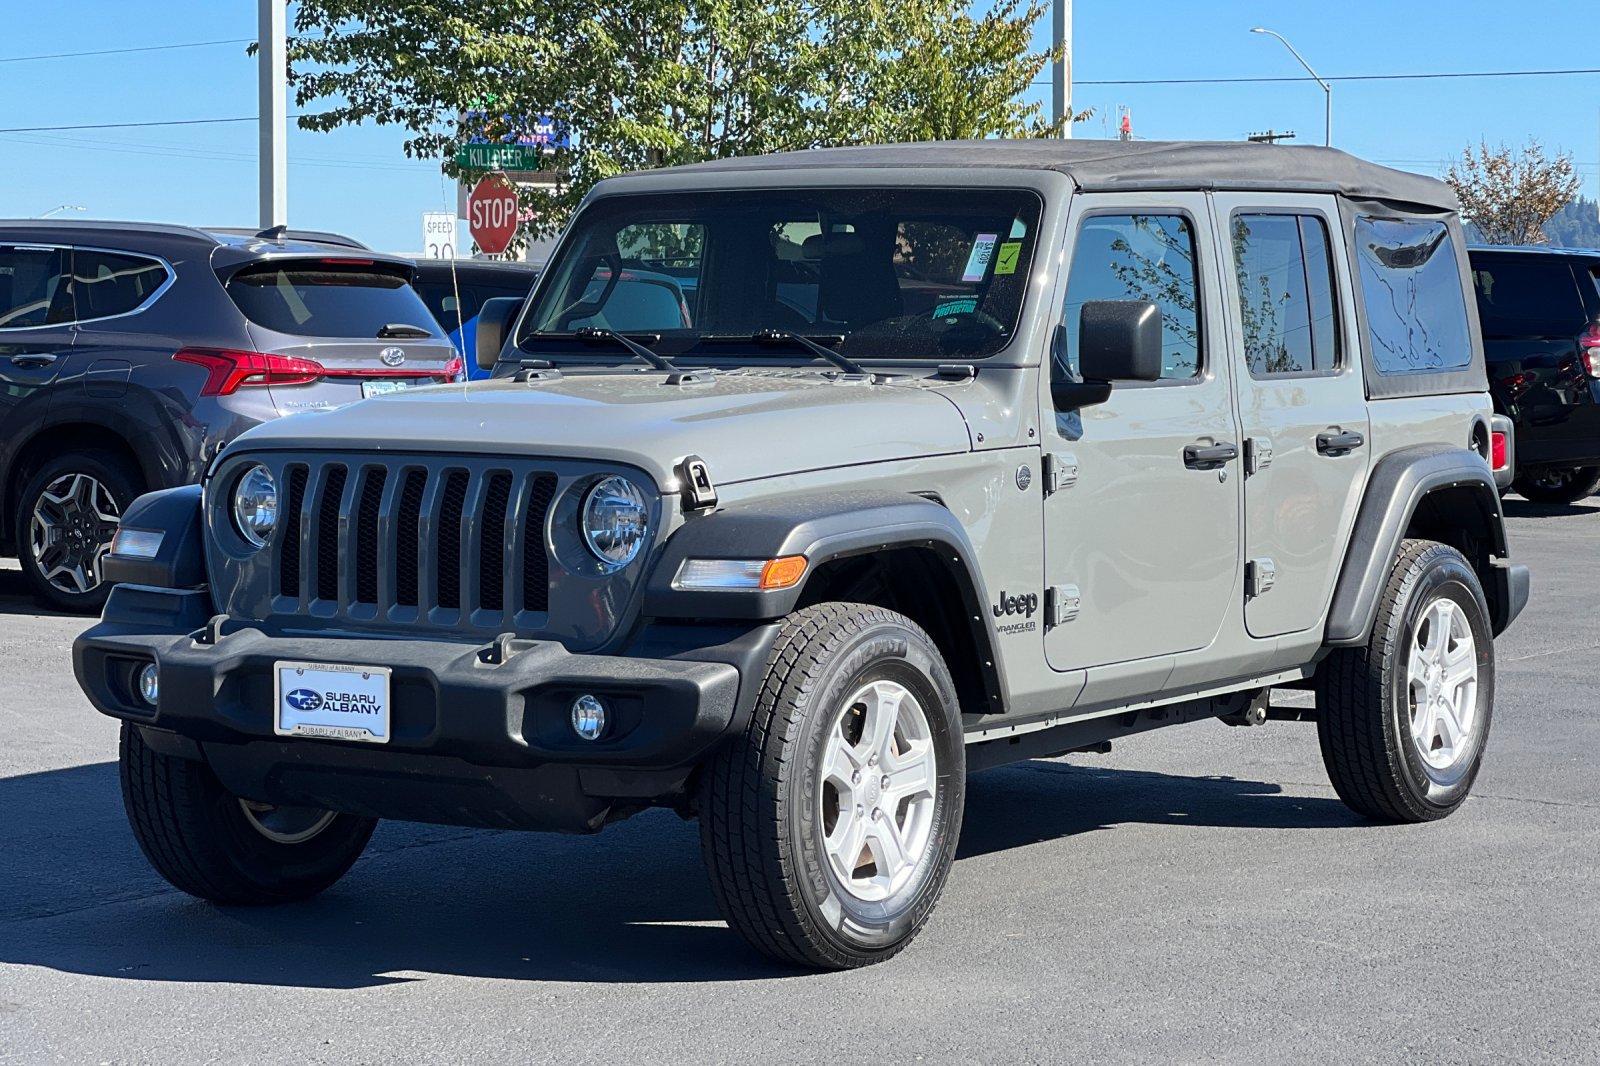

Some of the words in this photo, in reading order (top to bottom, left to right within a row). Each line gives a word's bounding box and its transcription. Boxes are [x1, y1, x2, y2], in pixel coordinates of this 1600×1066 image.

[469, 147, 523, 167] KILLDEER
[472, 198, 515, 230] STOP
[427, 221, 453, 233] SPEED
[429, 242, 455, 260] 30
[993, 590, 1038, 618] Jeep
[307, 663, 328, 671] SUBARU
[335, 665, 356, 673] ALBANY
[325, 691, 376, 705] SUBARU
[321, 701, 382, 716] ALBANY
[302, 727, 328, 736] SUBARU
[329, 728, 337, 737] of
[337, 729, 363, 739] ALBANY
